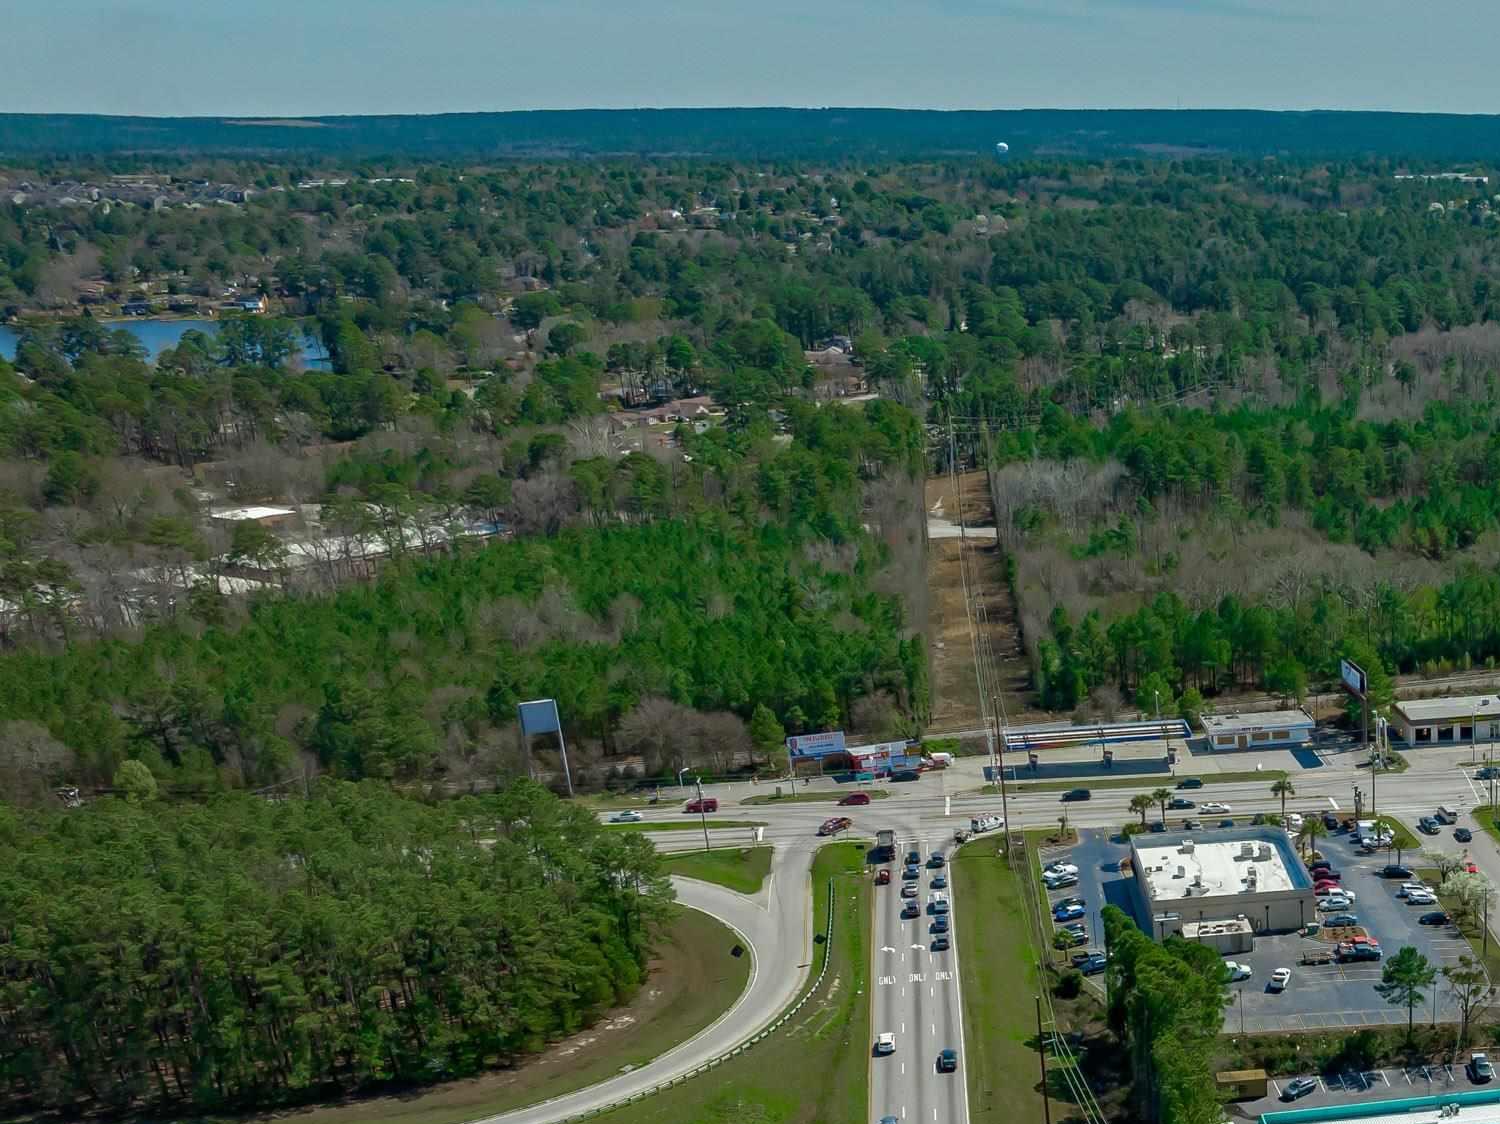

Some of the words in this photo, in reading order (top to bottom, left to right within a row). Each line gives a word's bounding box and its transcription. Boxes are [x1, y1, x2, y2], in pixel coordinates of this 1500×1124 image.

[878, 976, 896, 985] ONLY
[909, 973, 927, 983] ONLY
[935, 971, 953, 981] ONLY
